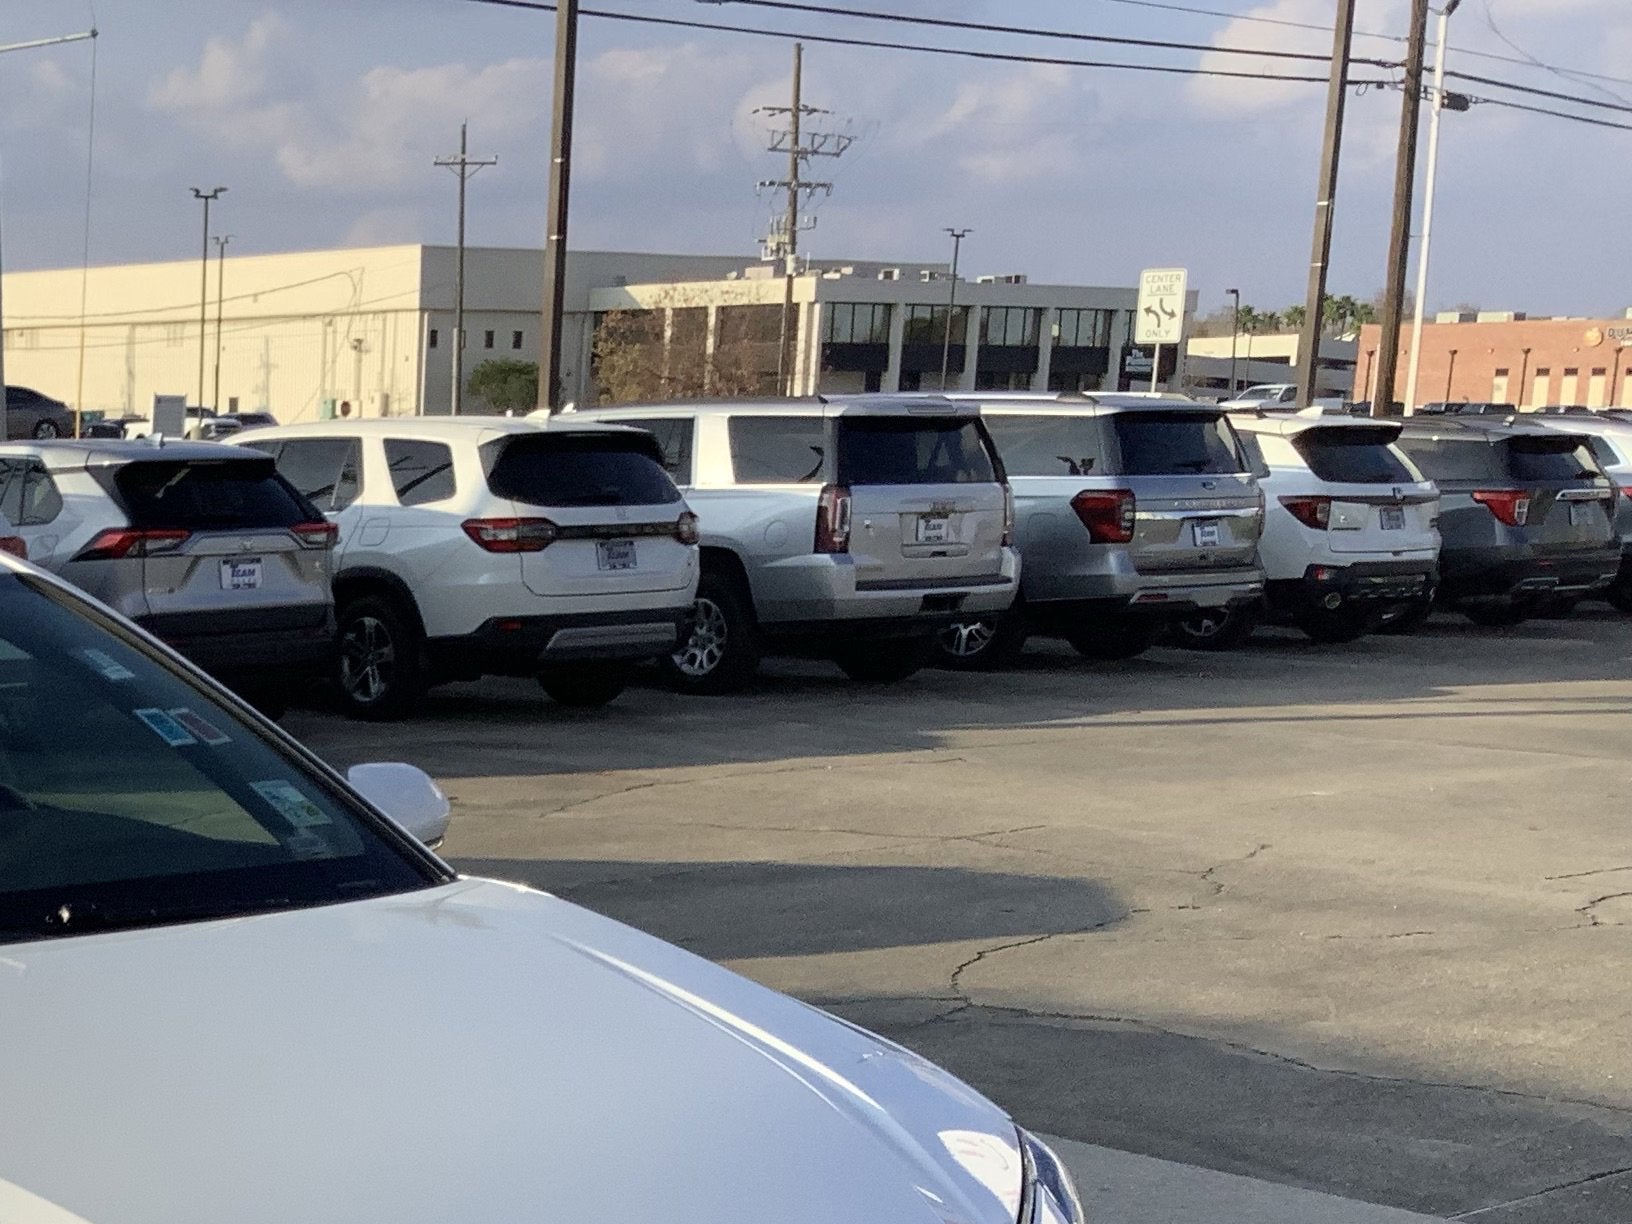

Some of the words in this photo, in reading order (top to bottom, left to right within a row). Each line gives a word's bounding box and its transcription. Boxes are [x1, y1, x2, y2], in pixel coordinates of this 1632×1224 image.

[1145, 273, 1181, 284] CENTER
[1150, 283, 1176, 294] LANE
[1145, 328, 1171, 338] ONLY
